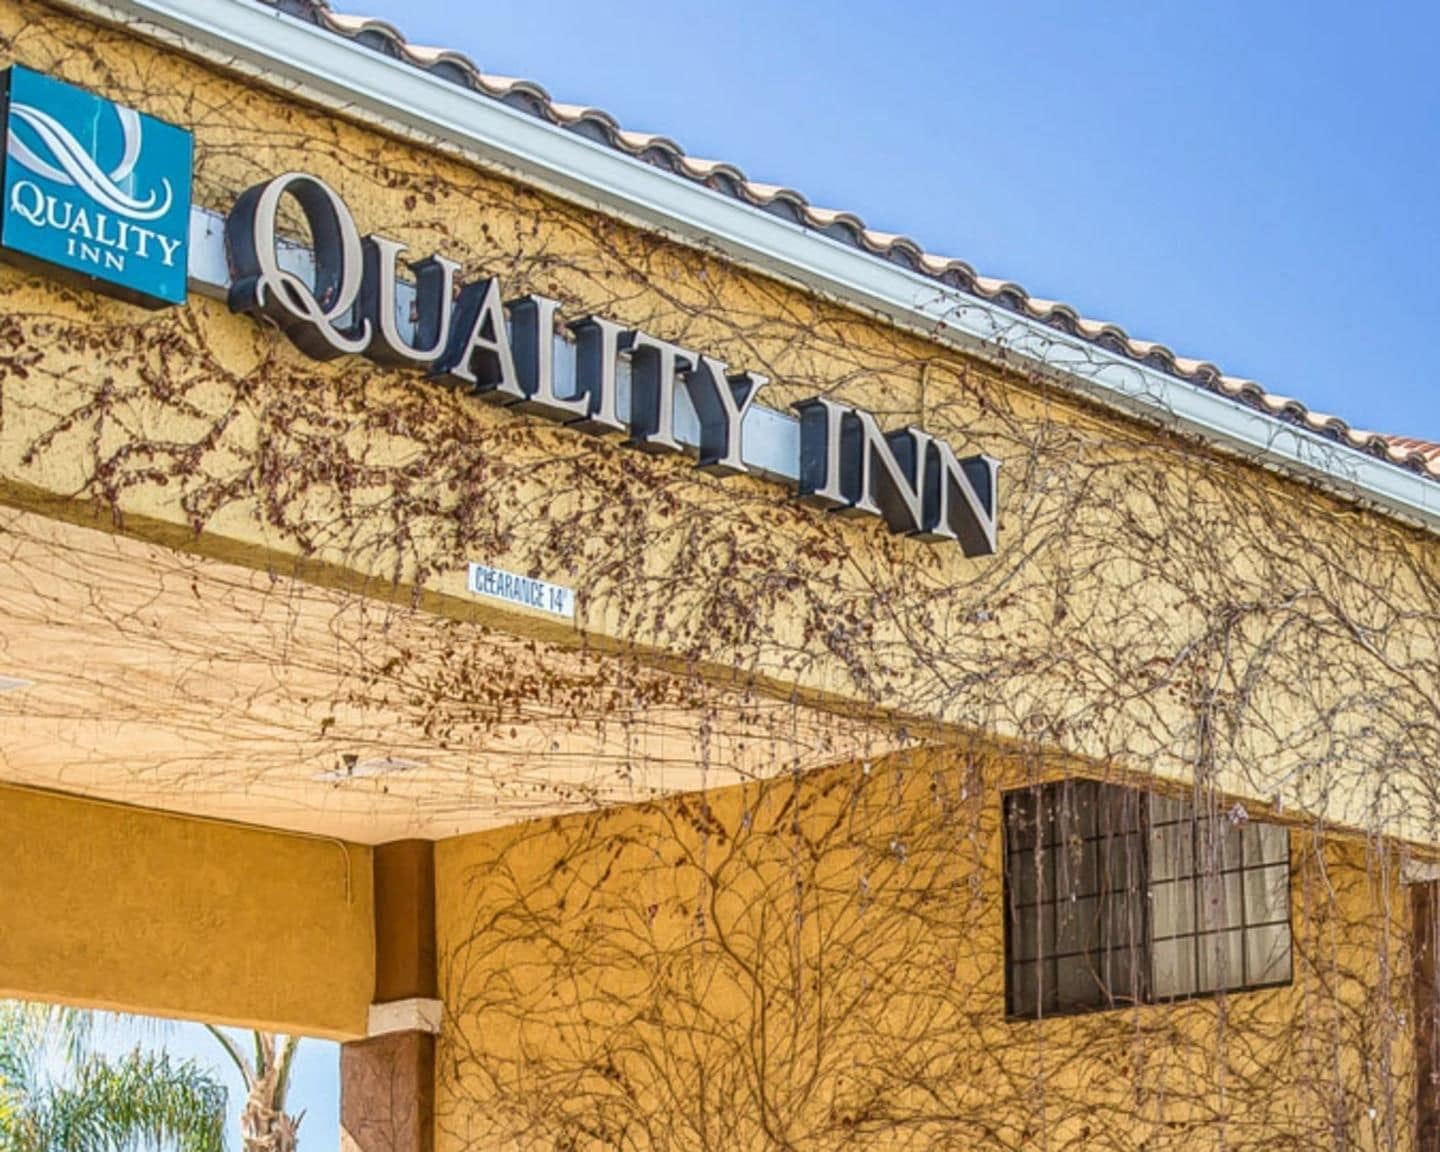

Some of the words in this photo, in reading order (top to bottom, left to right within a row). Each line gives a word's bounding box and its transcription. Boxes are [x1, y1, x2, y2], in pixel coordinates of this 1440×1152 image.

[10, 180, 182, 268] QUALITY
[67, 238, 125, 272] INN
[255, 172, 770, 472] QUALITY
[811, 397, 1002, 556] INN
[475, 566, 545, 608] CLEARANCE
